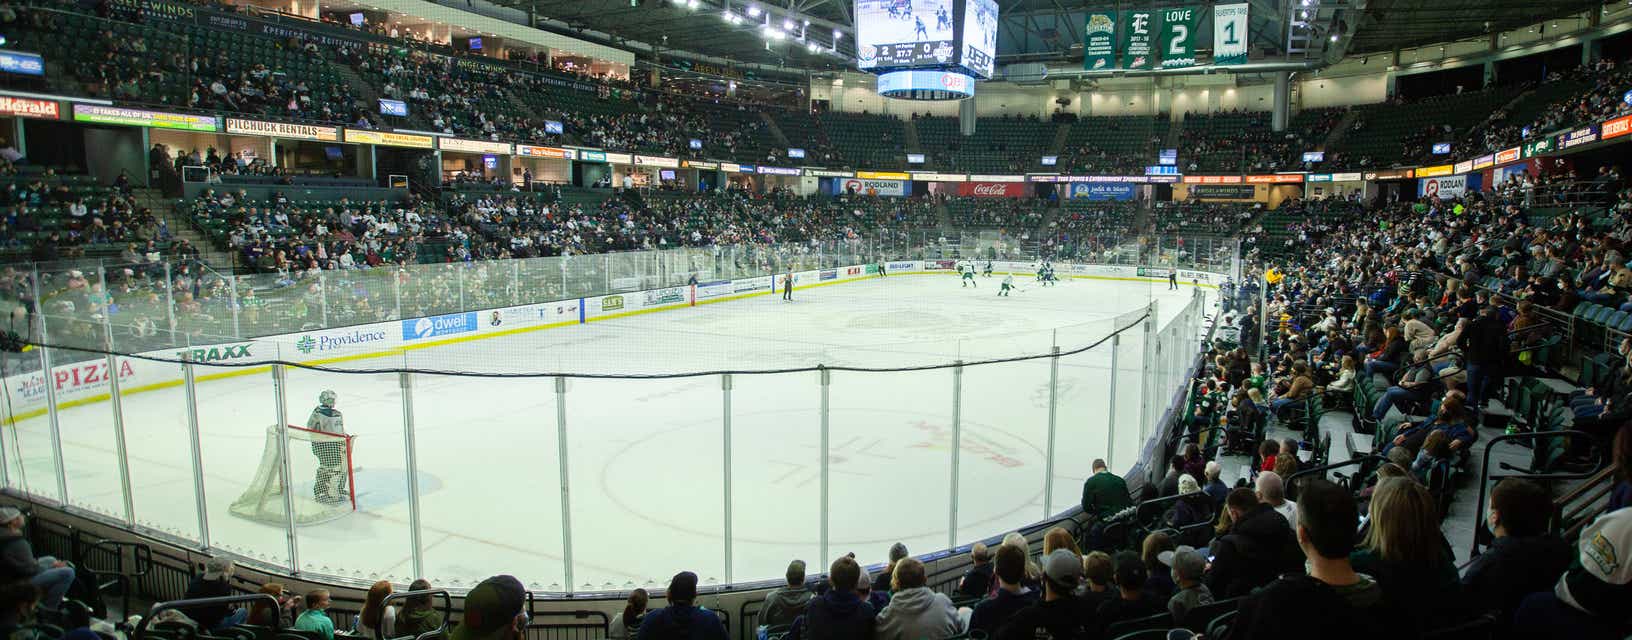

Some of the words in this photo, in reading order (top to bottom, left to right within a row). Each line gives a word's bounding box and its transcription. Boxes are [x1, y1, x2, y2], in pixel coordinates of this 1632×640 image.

[150, 1, 194, 18] WINDS
[1166, 10, 1191, 22] LOVE
[1132, 13, 1149, 34] E
[1169, 24, 1188, 55] 2
[1224, 20, 1239, 45] 1
[881, 46, 889, 56] 2
[923, 43, 931, 53] 0
[0, 96, 57, 116] Herald
[227, 119, 277, 133] PILCHUCK
[279, 124, 318, 137] RENTALS
[864, 181, 899, 189] RODLAND
[435, 314, 467, 330] dwell
[319, 331, 386, 351] Providence
